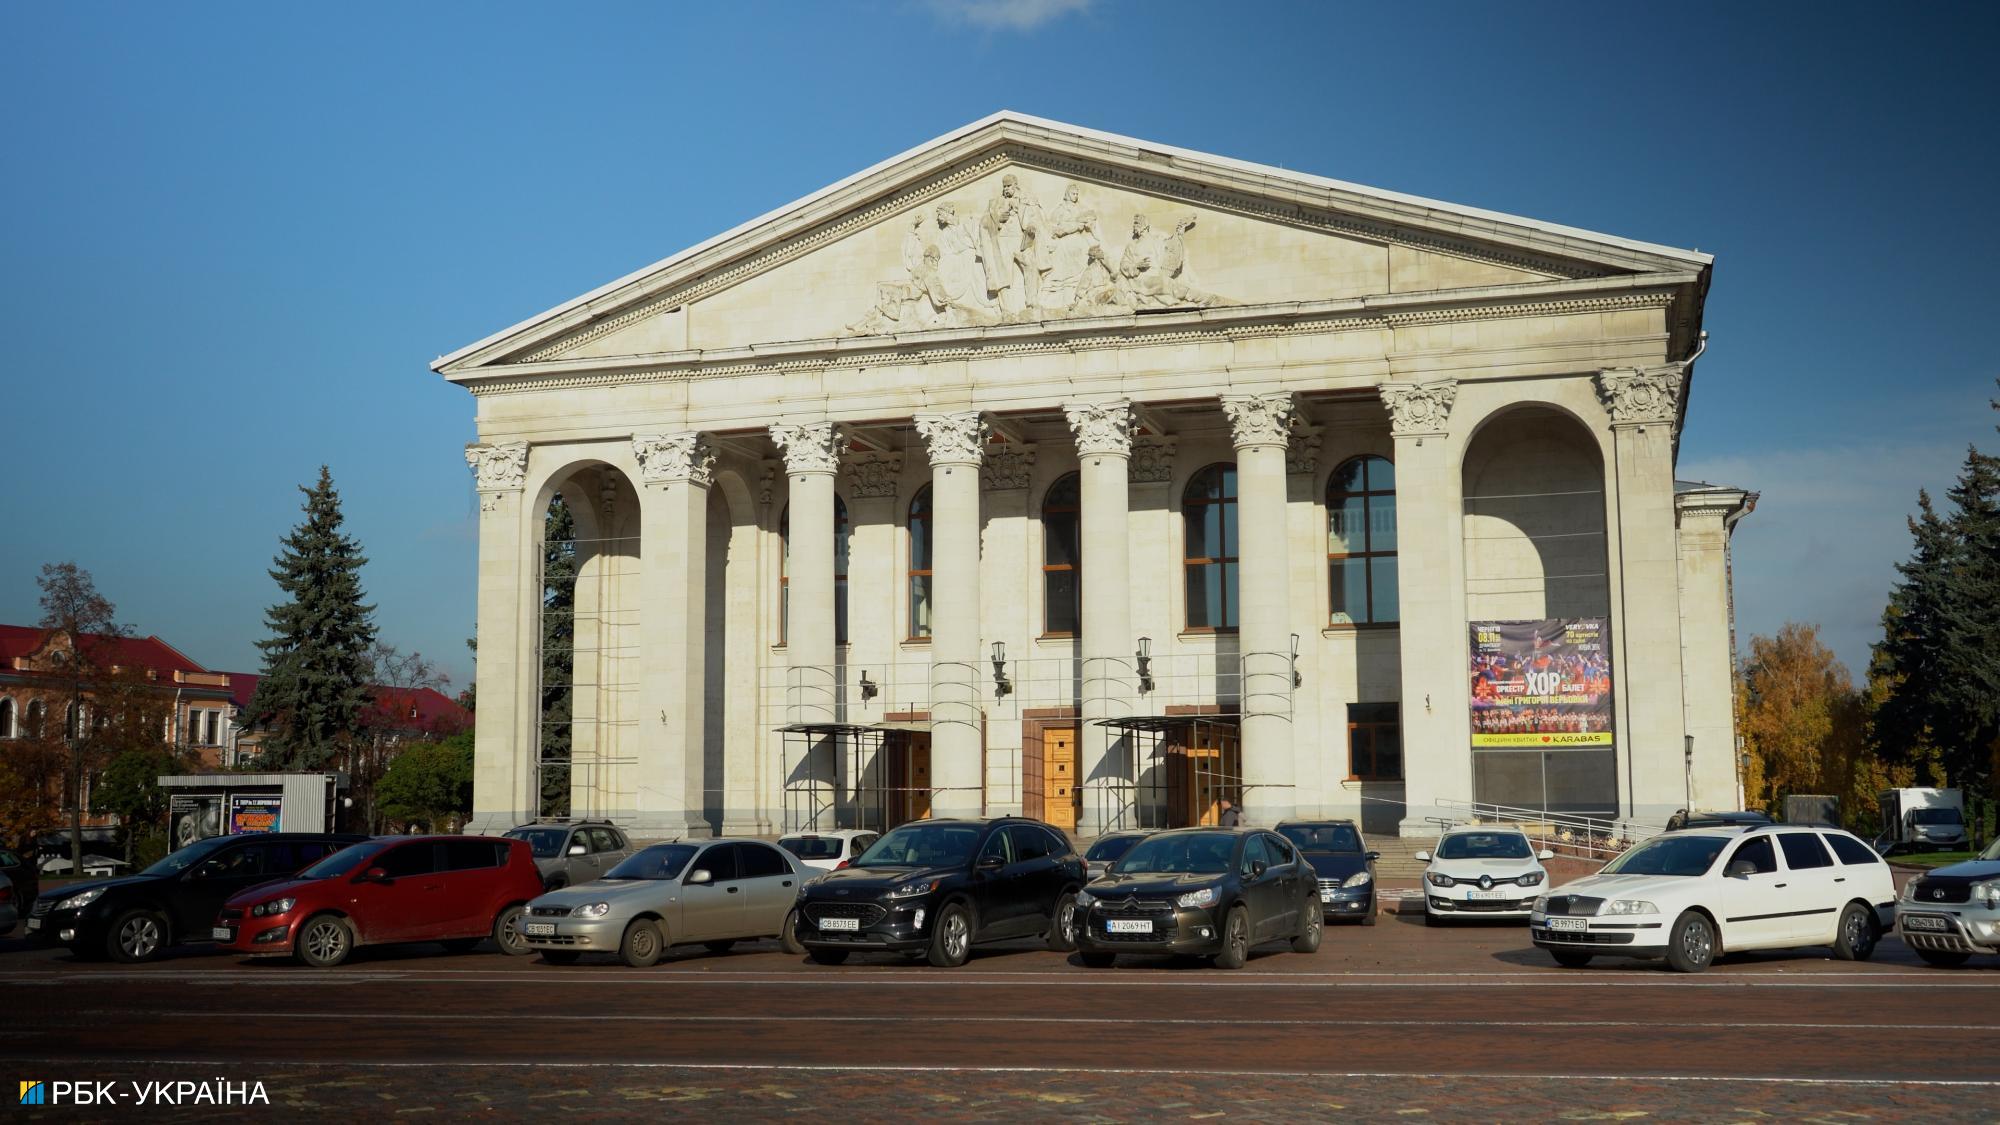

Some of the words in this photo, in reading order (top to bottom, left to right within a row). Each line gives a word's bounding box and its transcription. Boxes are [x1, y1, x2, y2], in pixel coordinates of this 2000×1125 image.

[1496, 685, 1525, 693] ОРКЕСТР
[1525, 672, 1561, 696] ХОР
[1562, 684, 1585, 692] БАЛЕТ
[823, 920, 832, 928] CB
[847, 920, 856, 929] EE
[1551, 919, 1559, 928] CB
[1560, 919, 1574, 928] 9971
